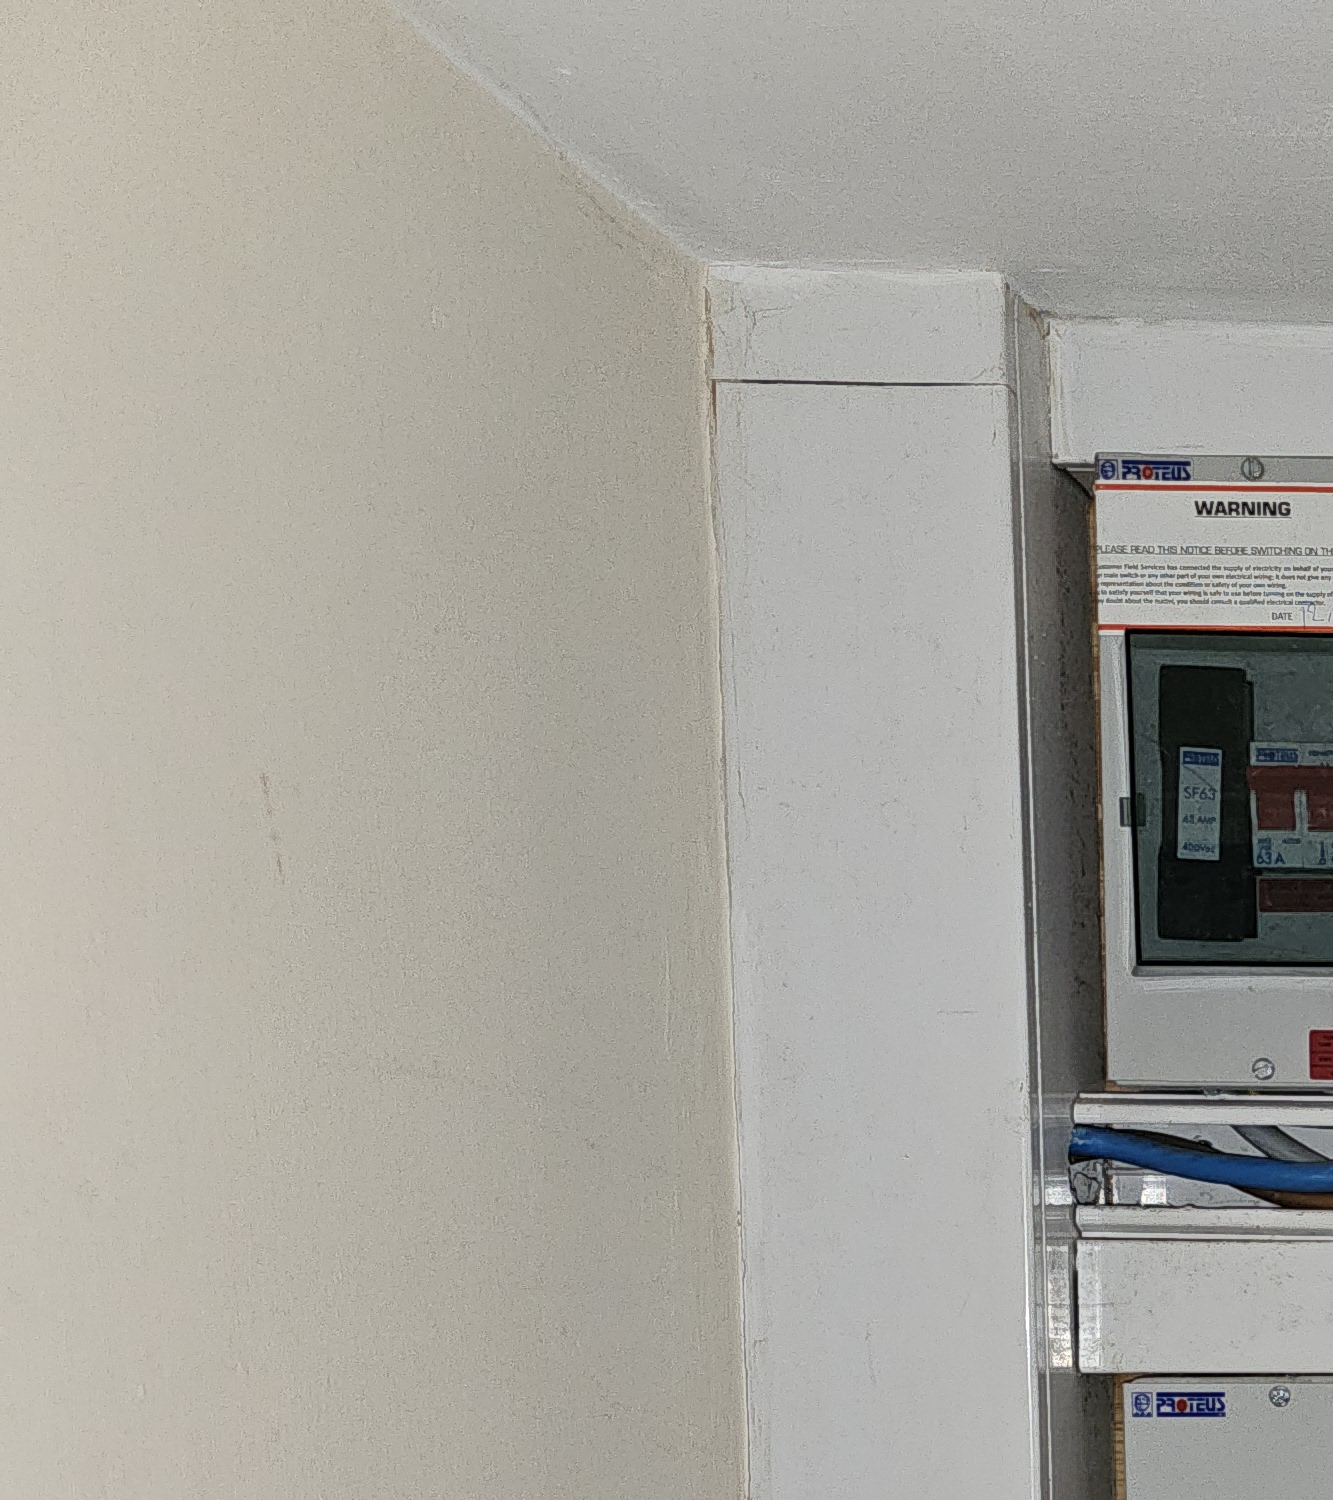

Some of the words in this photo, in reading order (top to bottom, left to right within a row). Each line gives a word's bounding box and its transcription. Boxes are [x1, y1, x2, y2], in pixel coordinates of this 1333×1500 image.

[1121, 460, 1192, 481] PROTEUS
[1194, 500, 1292, 516] WARNING
[1271, 611, 1293, 621] DATE
[1156, 1391, 1226, 1418] PROTEUS
